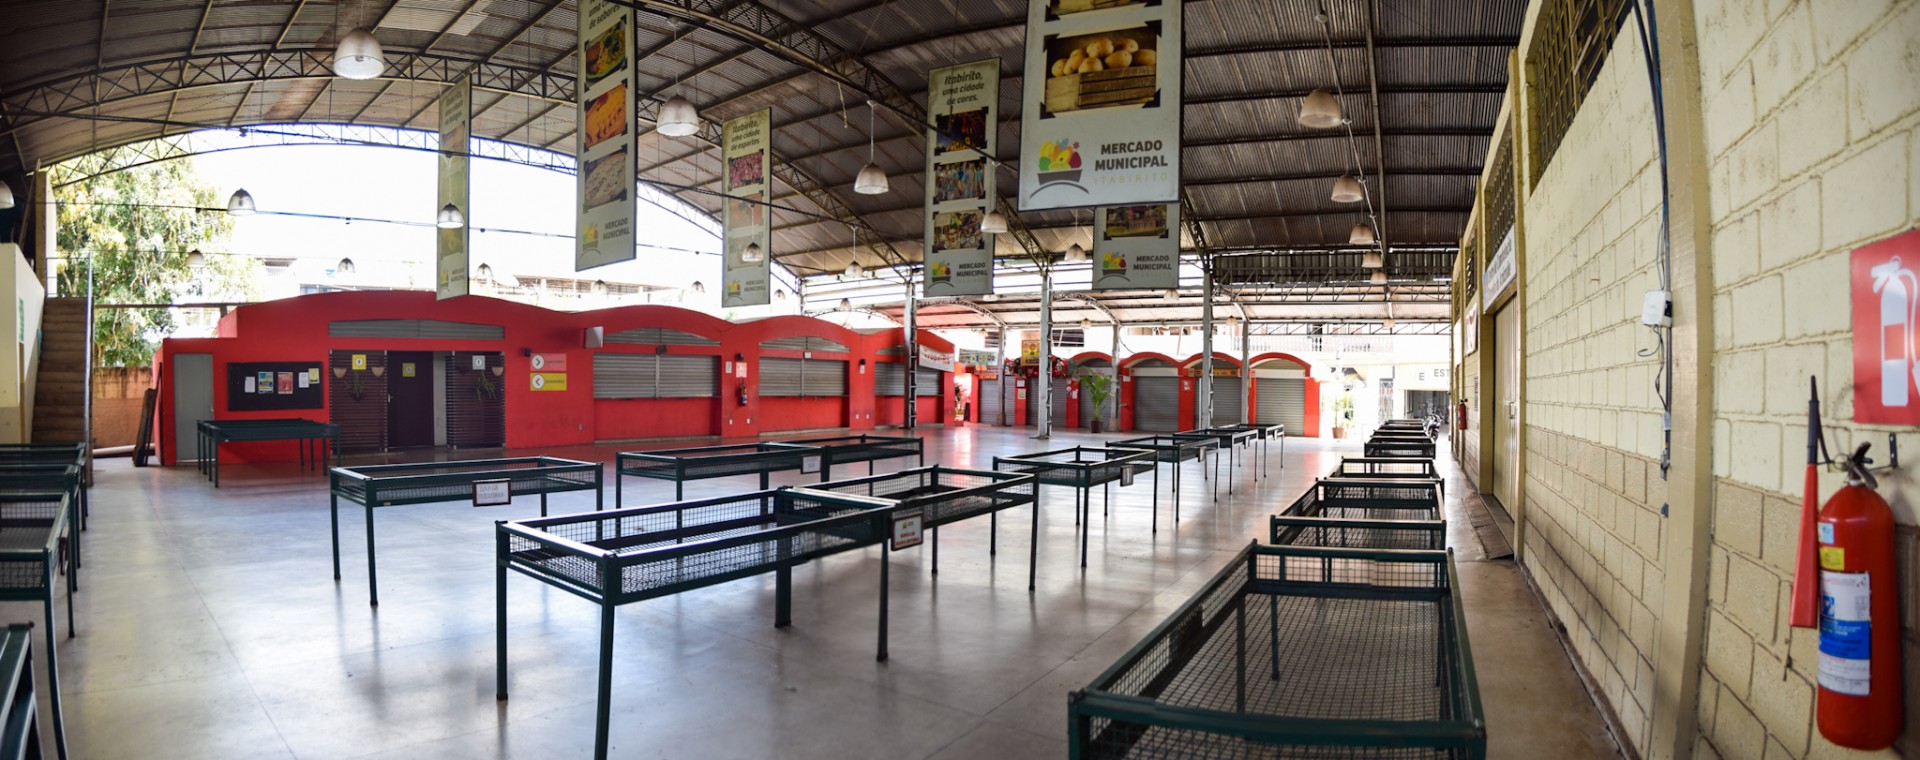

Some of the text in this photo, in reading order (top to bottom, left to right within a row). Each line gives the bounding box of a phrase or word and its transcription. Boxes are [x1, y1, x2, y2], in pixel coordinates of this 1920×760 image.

[944, 71, 983, 85] Itabirito,
[942, 82, 984, 96] uma cidade
[946, 95, 978, 106] de cores.
[743, 129, 760, 139] cidade
[1100, 140, 1163, 155] MERCADO
[1094, 155, 1168, 171] MUNICIPAL
[1095, 173, 1168, 185] ITABIRITO
[605, 217, 628, 230] MERCADO
[602, 227, 630, 240] MUNICIPAL
[958, 262, 986, 270] MERCADO
[1419, 372, 1425, 380] E
